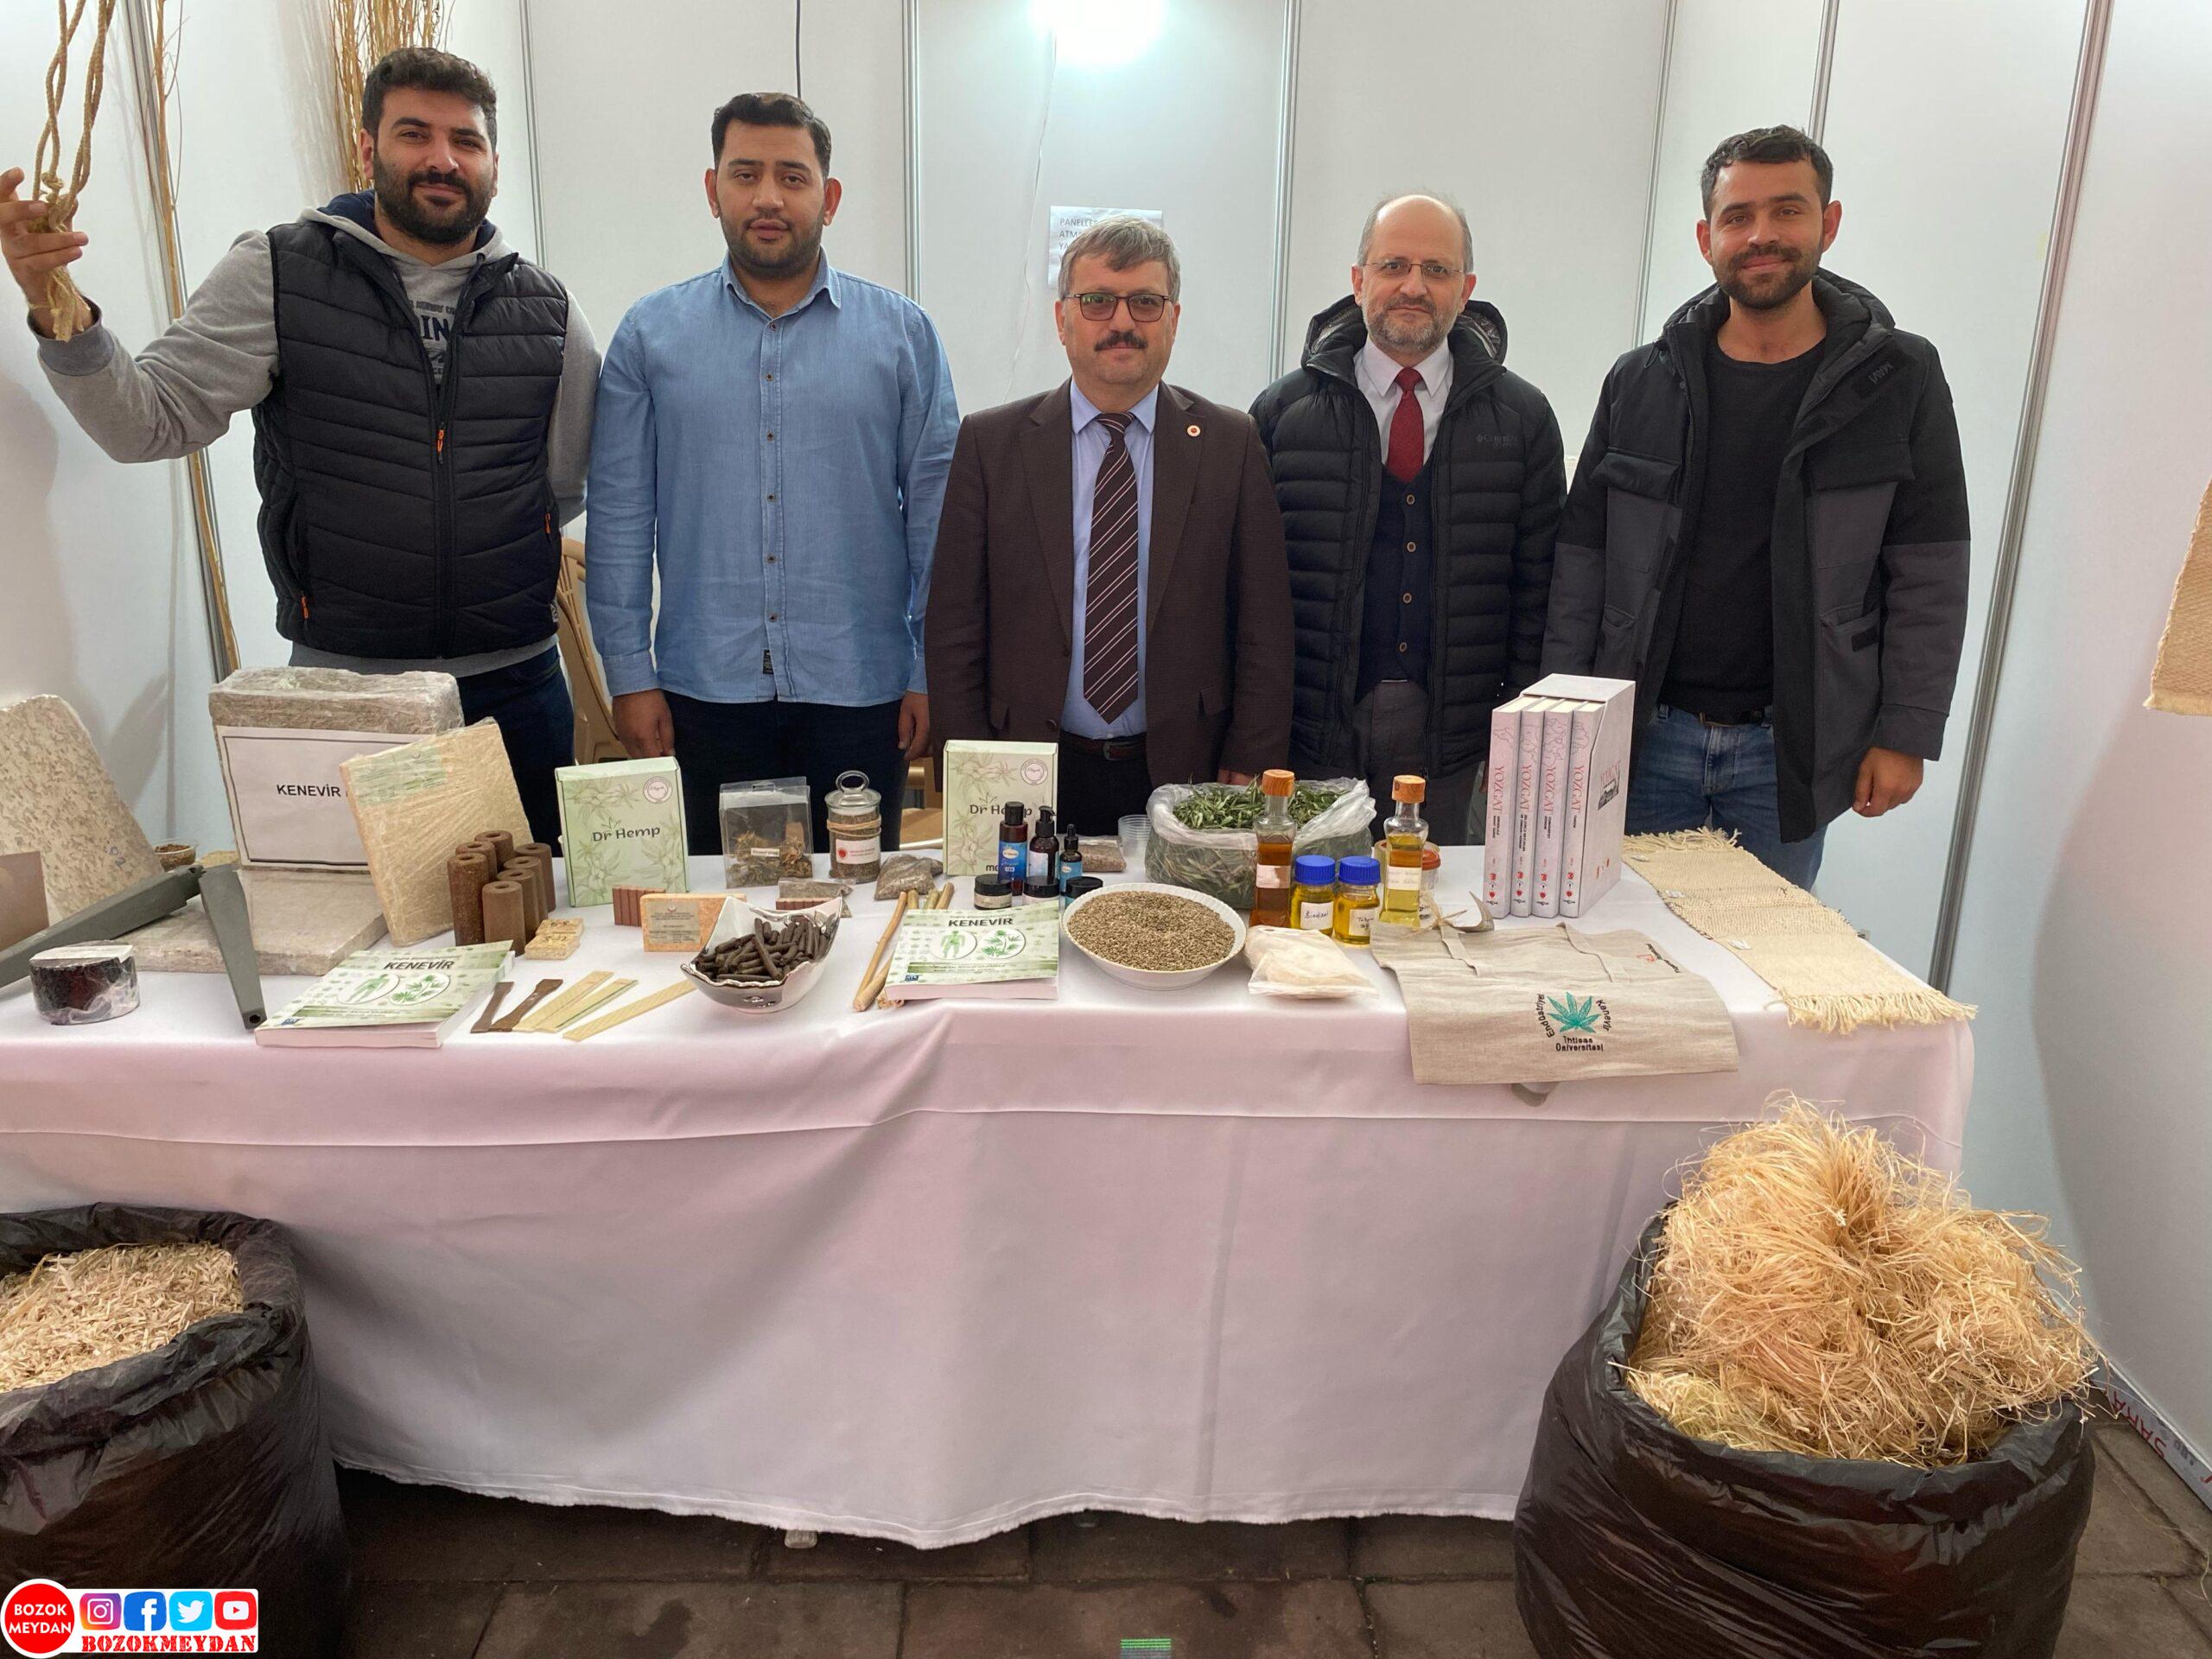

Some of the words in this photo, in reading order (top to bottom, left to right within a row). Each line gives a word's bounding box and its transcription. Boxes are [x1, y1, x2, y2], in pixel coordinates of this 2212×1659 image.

[276, 784, 341, 797] KENEVİR
[1493, 766, 1504, 814] YOZGAT
[1520, 764, 1532, 813] YOZGAT
[1543, 766, 1556, 815] YOZGAT
[1572, 765, 1584, 813] YOZGAT
[969, 804, 988, 815] Dr
[593, 832, 612, 842] Dr
[615, 827, 660, 840] Hemp
[948, 918, 1014, 927] KENEVİR
[384, 959, 455, 970] KENEVİR
